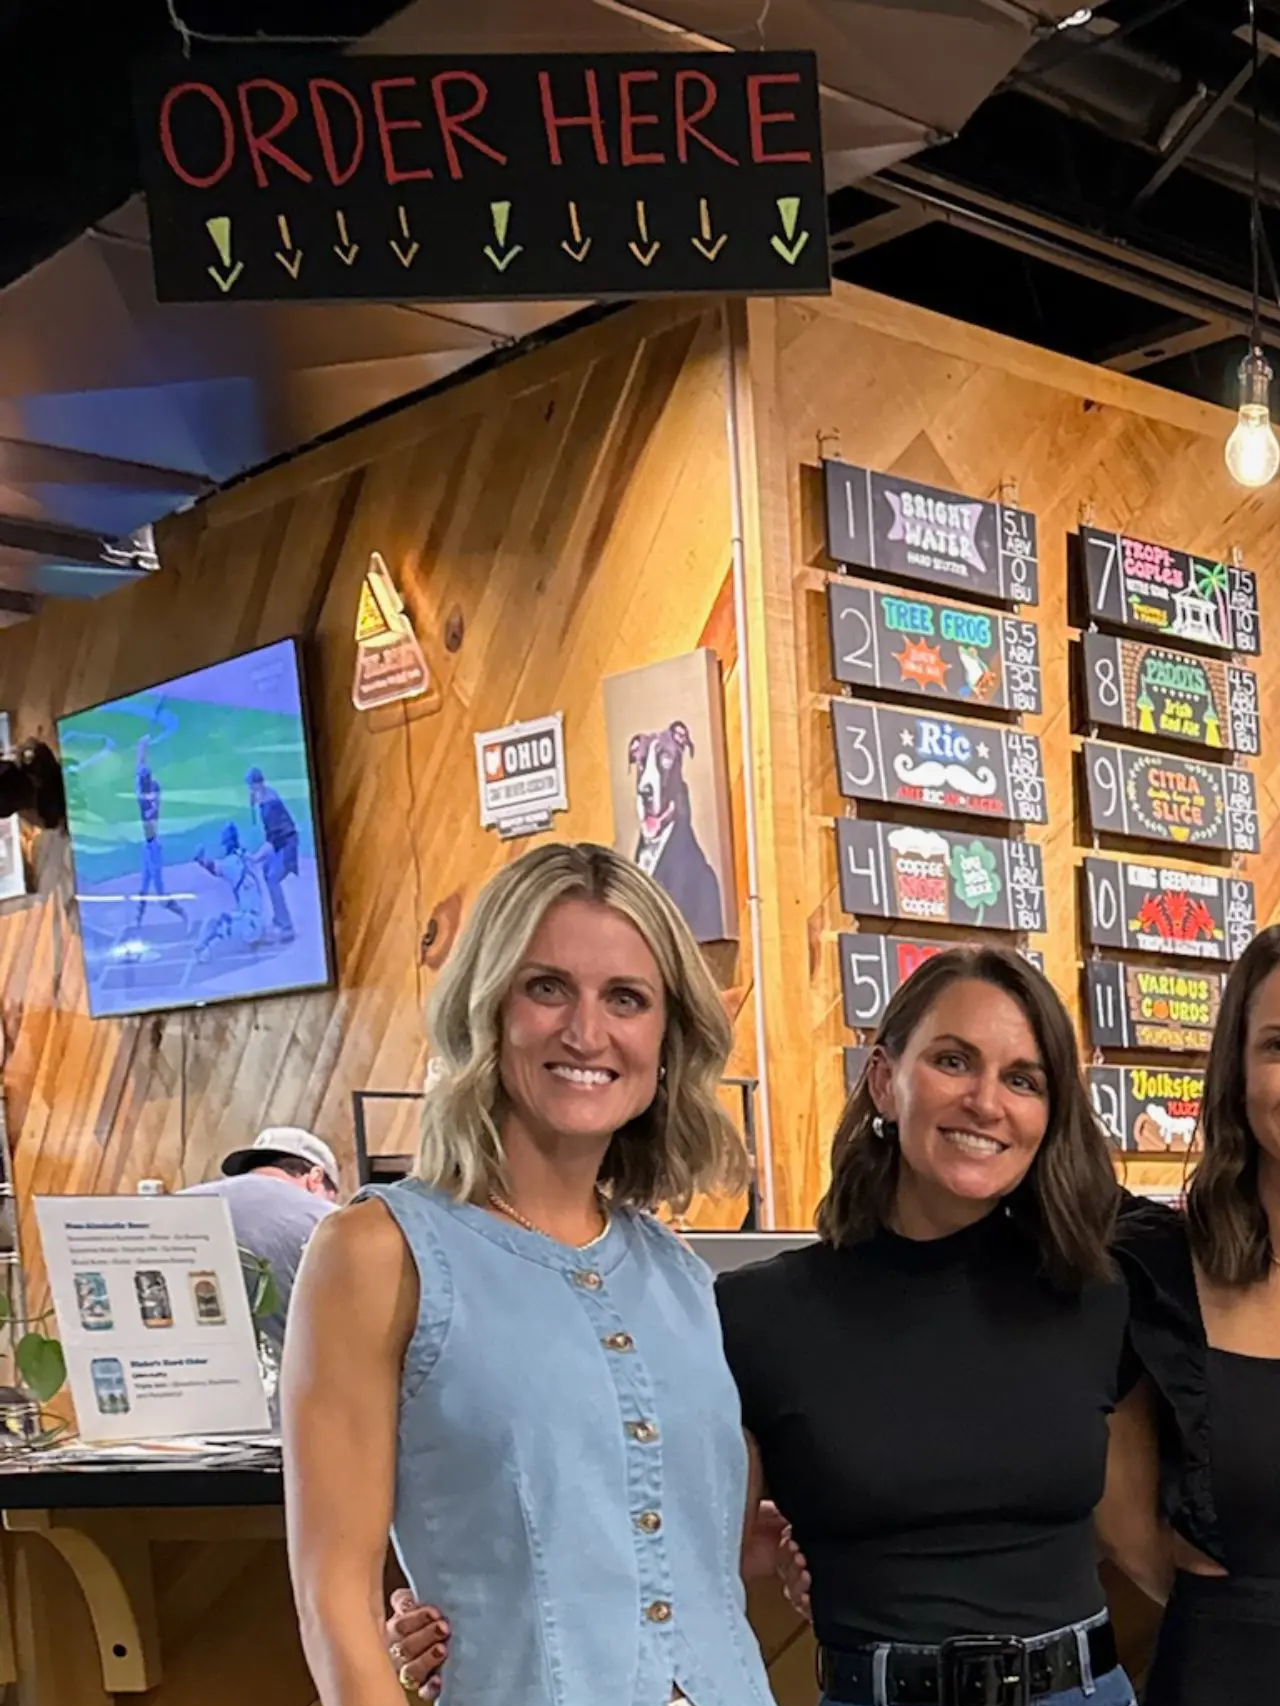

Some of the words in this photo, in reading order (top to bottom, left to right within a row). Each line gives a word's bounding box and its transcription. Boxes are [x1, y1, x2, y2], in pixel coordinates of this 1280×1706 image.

[160, 75, 508, 188] ORDER
[538, 69, 813, 166] HERE
[846, 481, 855, 539] 1
[901, 491, 971, 532] BRIGHT
[903, 520, 973, 560] WATER
[1088, 538, 1116, 610] 7
[840, 607, 872, 669] 2
[881, 597, 934, 636] TREE
[940, 609, 991, 648] FROG
[1004, 620, 1036, 647] 5.5
[1095, 658, 1119, 706] 8
[504, 737, 553, 774] OHIO
[846, 726, 875, 785] 3
[918, 720, 971, 763] Ric
[1094, 757, 1117, 816] 9
[1148, 768, 1200, 795] CITRA
[1152, 799, 1203, 826] SLICE
[1232, 812, 1256, 835] 56
[848, 846, 878, 905] 4
[896, 858, 945, 878] COFFEE
[901, 898, 945, 917] COFFEE
[1088, 871, 1117, 929] 10
[850, 953, 881, 1018] 5
[1096, 983, 1114, 1028] 11
[1137, 972, 1209, 1000] VARIOUS
